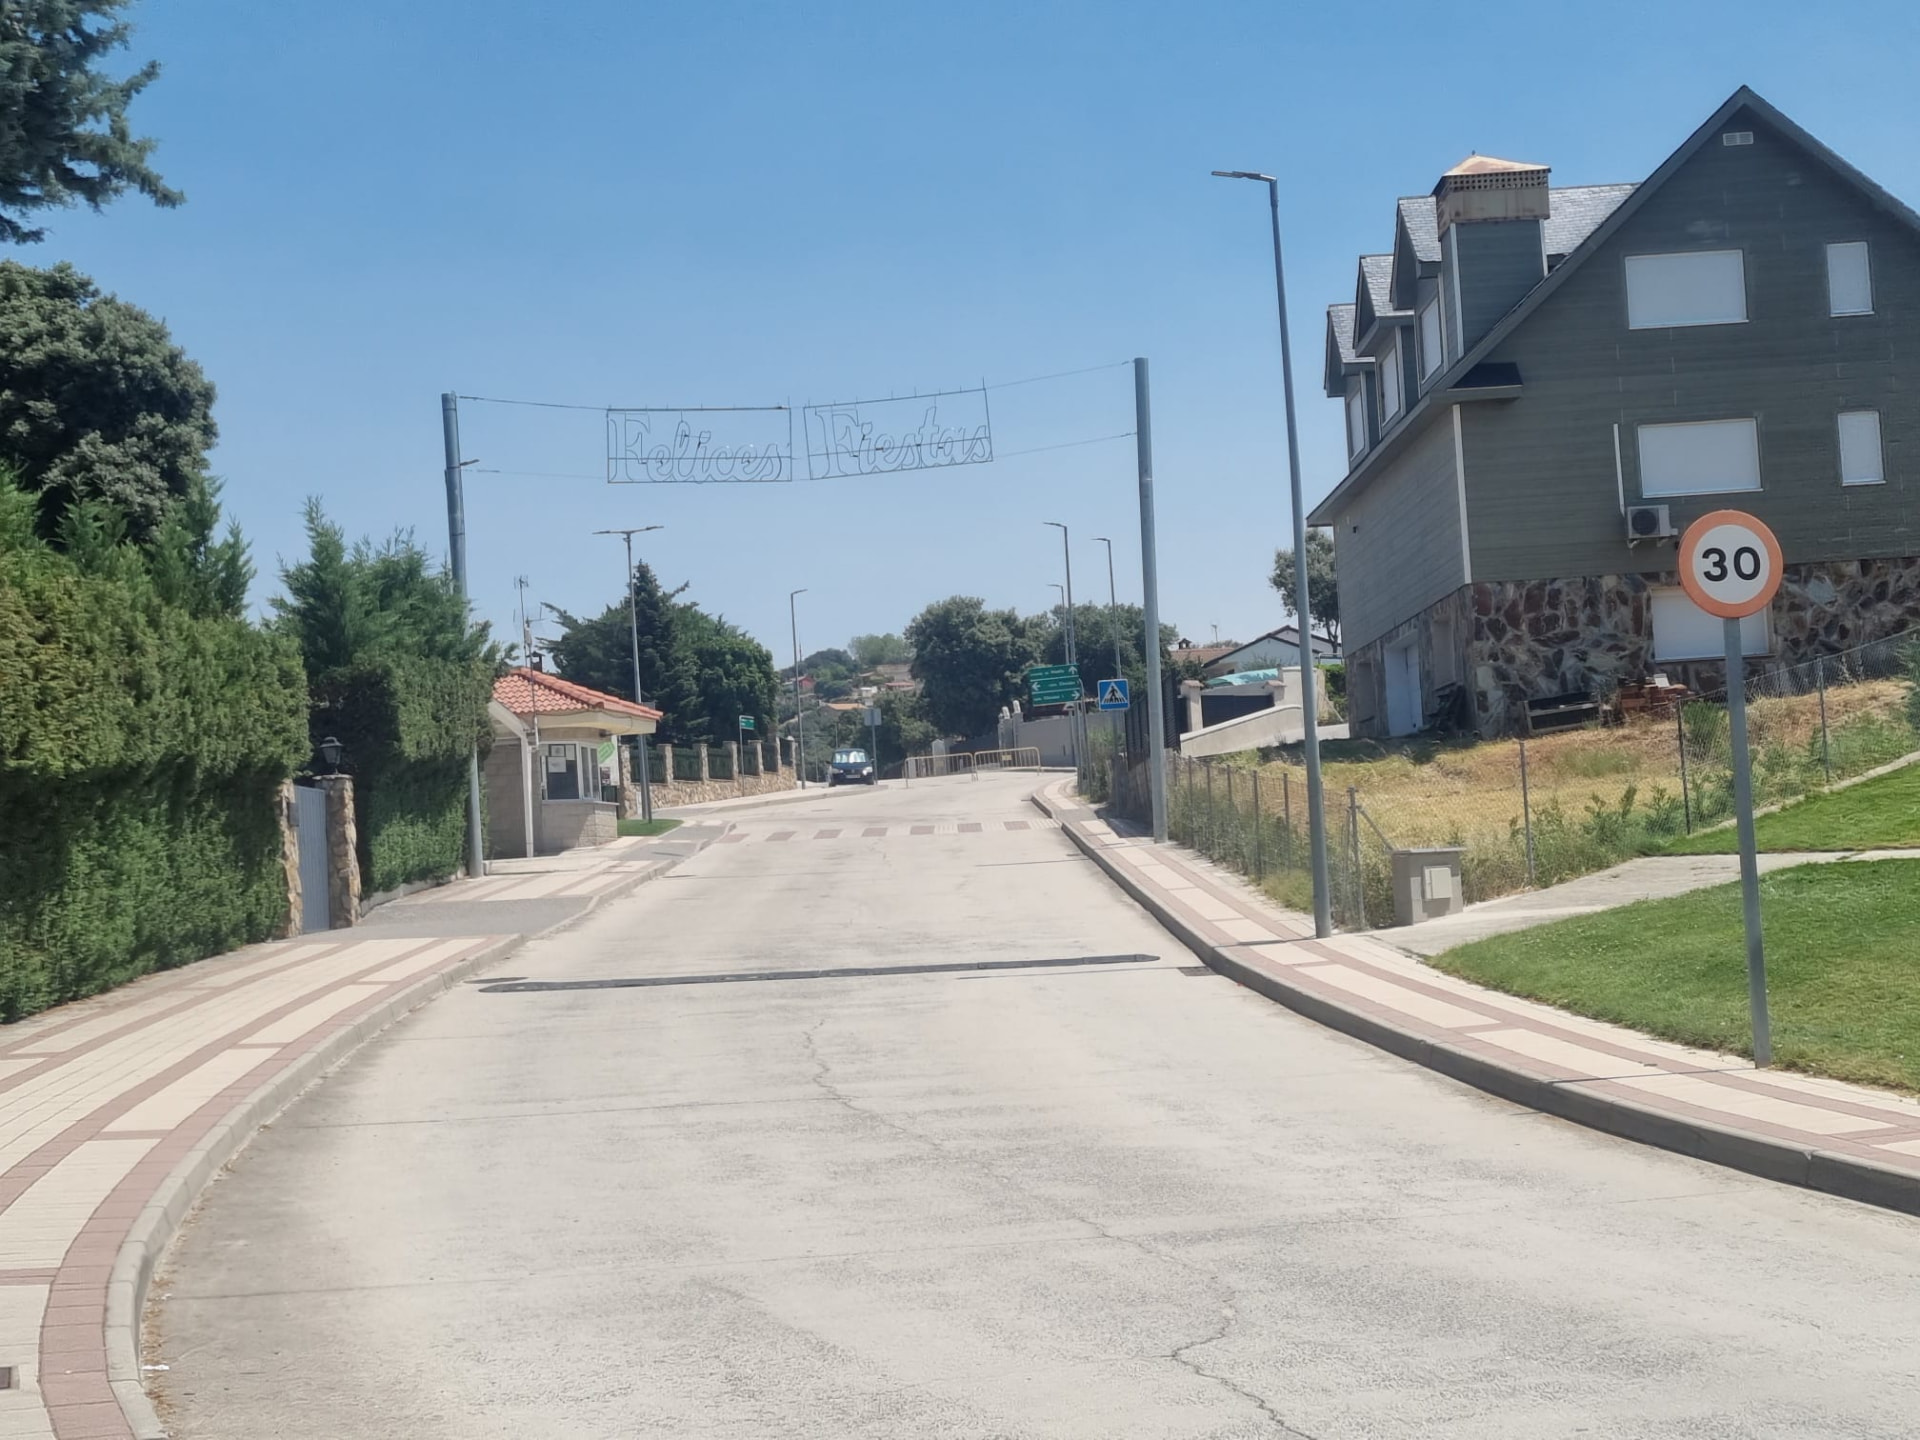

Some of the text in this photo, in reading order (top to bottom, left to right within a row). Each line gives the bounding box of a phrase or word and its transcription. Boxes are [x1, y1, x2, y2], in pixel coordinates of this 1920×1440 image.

[607, 405, 992, 483] Felices Fiestas
[1702, 547, 1760, 582] 30
